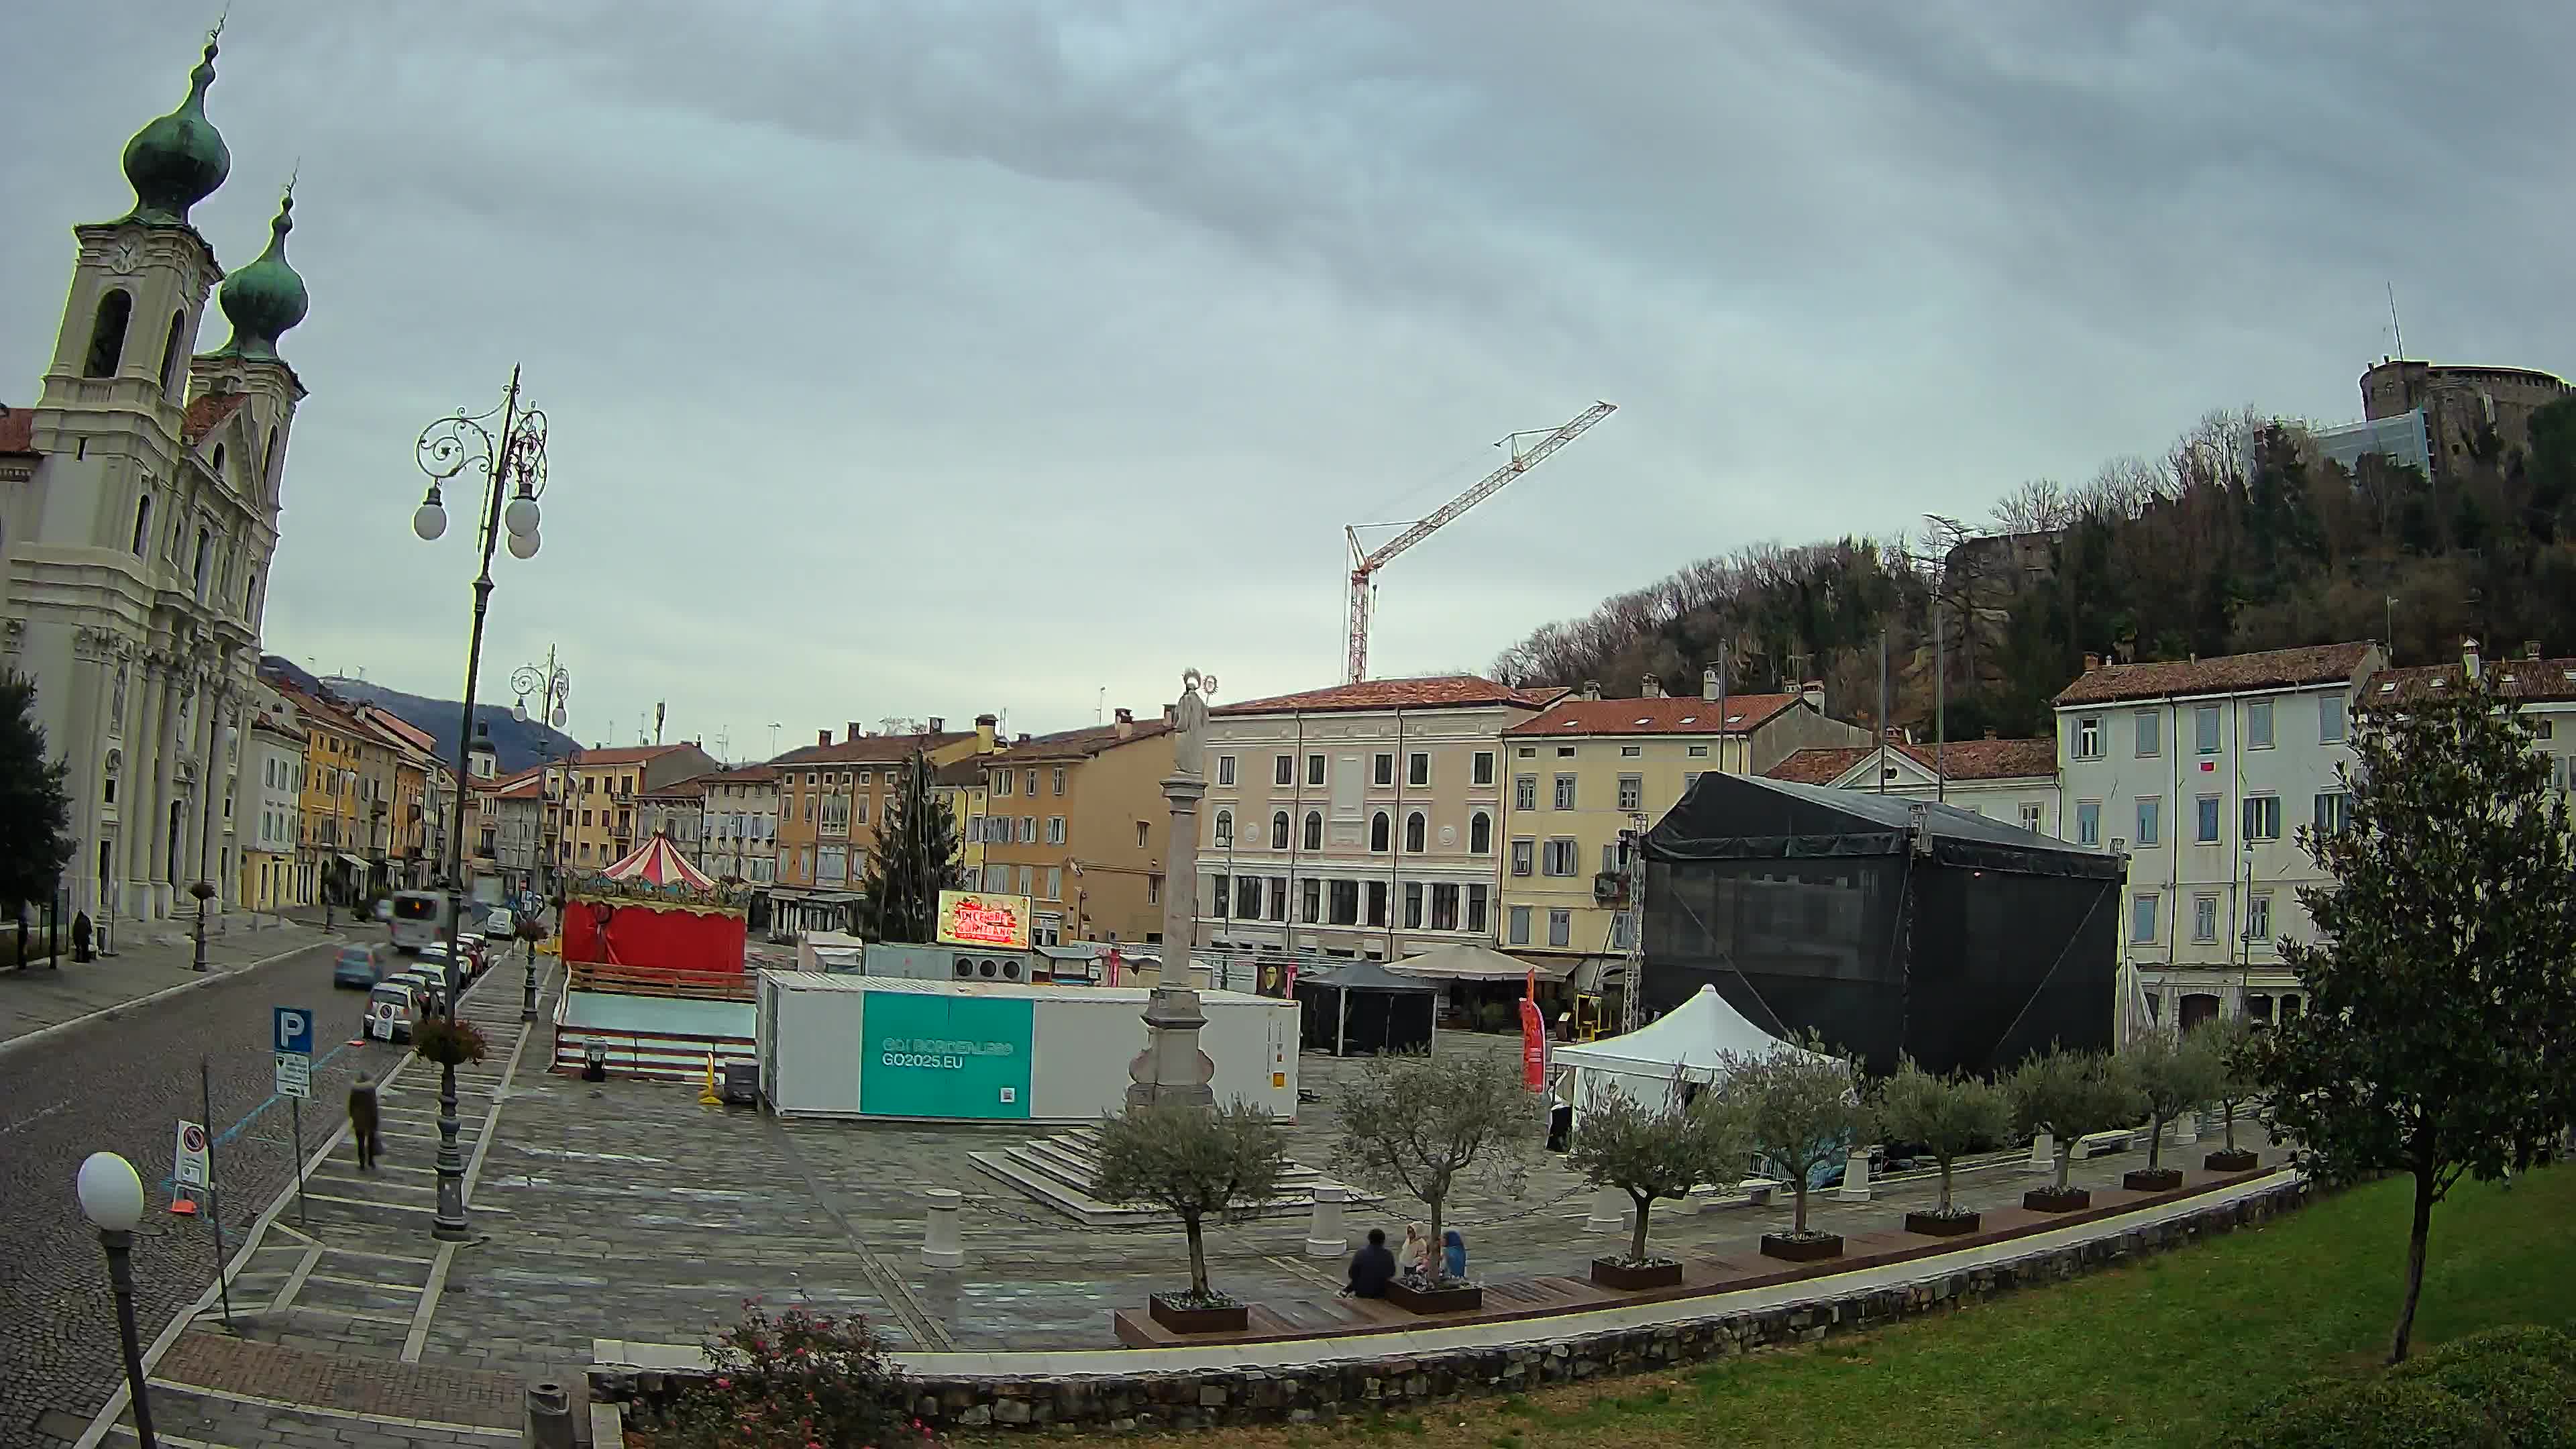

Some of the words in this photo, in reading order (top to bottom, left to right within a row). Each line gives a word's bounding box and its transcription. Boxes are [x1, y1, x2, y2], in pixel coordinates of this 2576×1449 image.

[961, 911, 1008, 924] DICEMBRE
[280, 1012, 305, 1047] P
[882, 1053, 963, 1069] GO2025.EU
